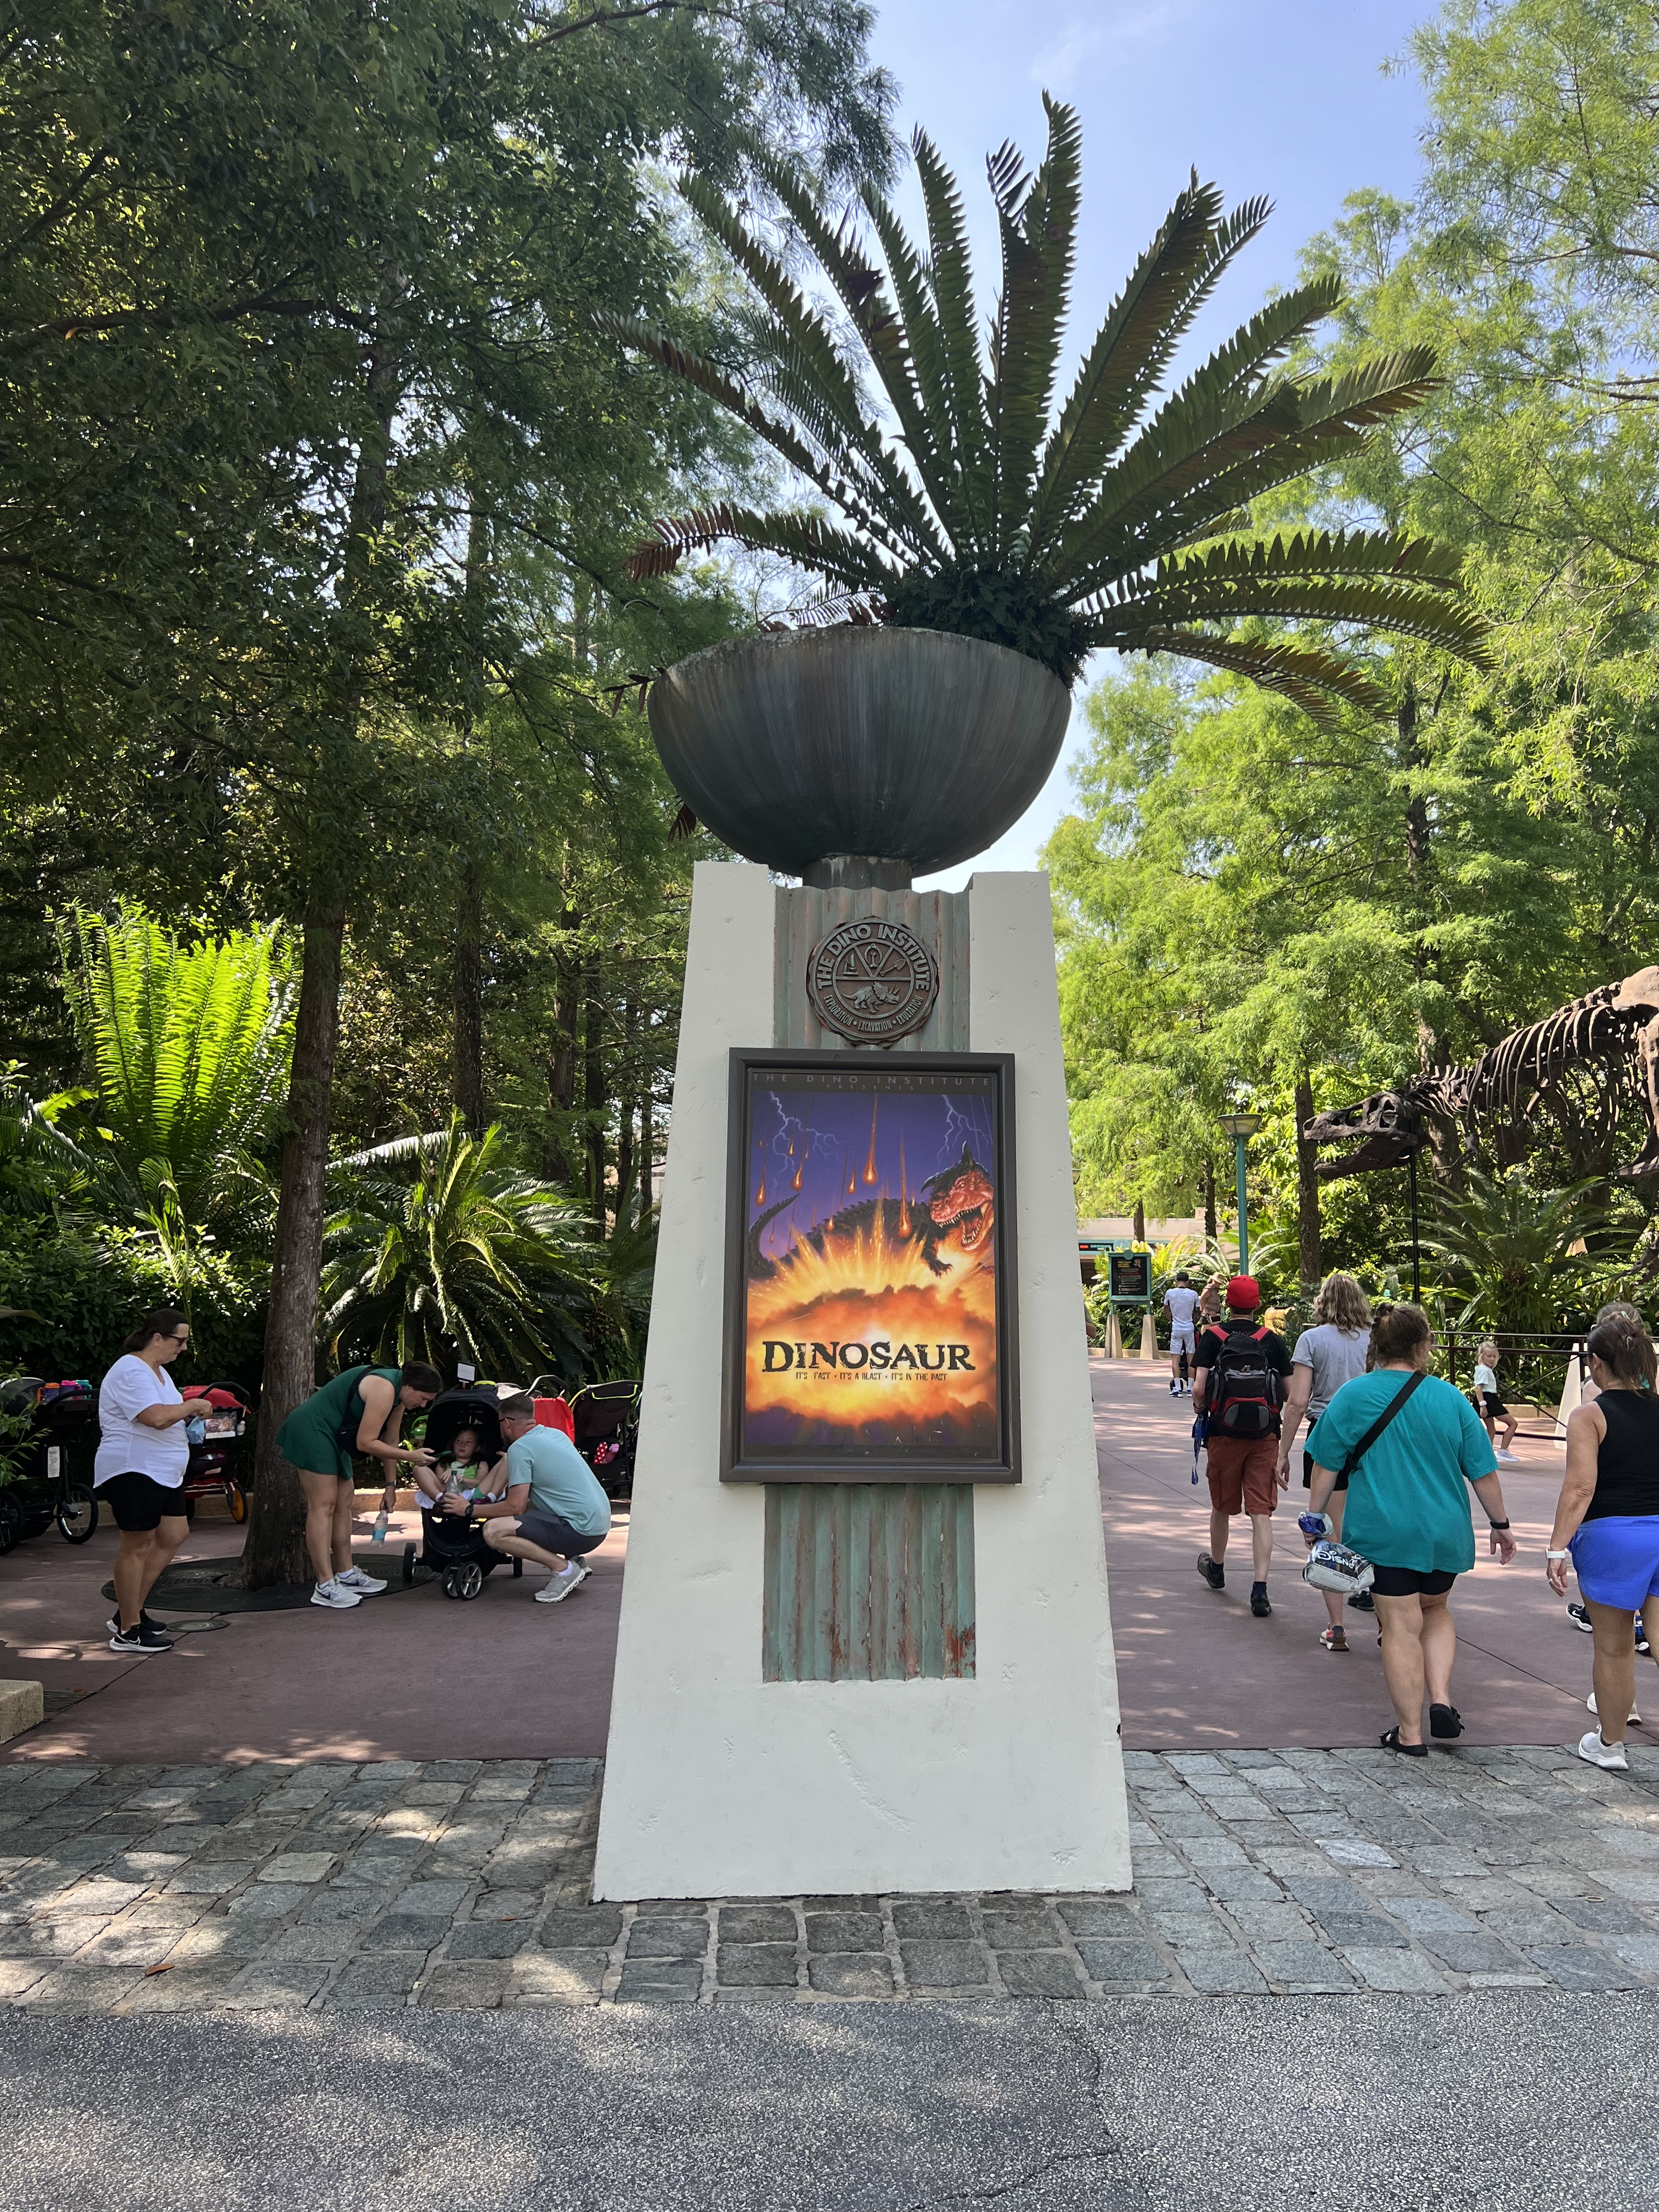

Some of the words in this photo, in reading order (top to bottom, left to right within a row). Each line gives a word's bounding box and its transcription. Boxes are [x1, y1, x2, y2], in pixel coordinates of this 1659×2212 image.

[817, 956, 835, 990] THE
[827, 924, 871, 956] DINO
[877, 924, 930, 991] INSTITUTE
[823, 995, 854, 1026] EXPLORATION
[857, 1019, 893, 1032] EXCAVATION
[895, 995, 924, 1025] EXULTATION
[806, 1075, 858, 1084] DINO
[877, 1076, 989, 1086] INSTITUTE
[761, 1341, 976, 1372] DINOSAUR
[795, 1372, 808, 1380] IT'S
[814, 1372, 831, 1380] FAST
[915, 1373, 928, 1381] THE
